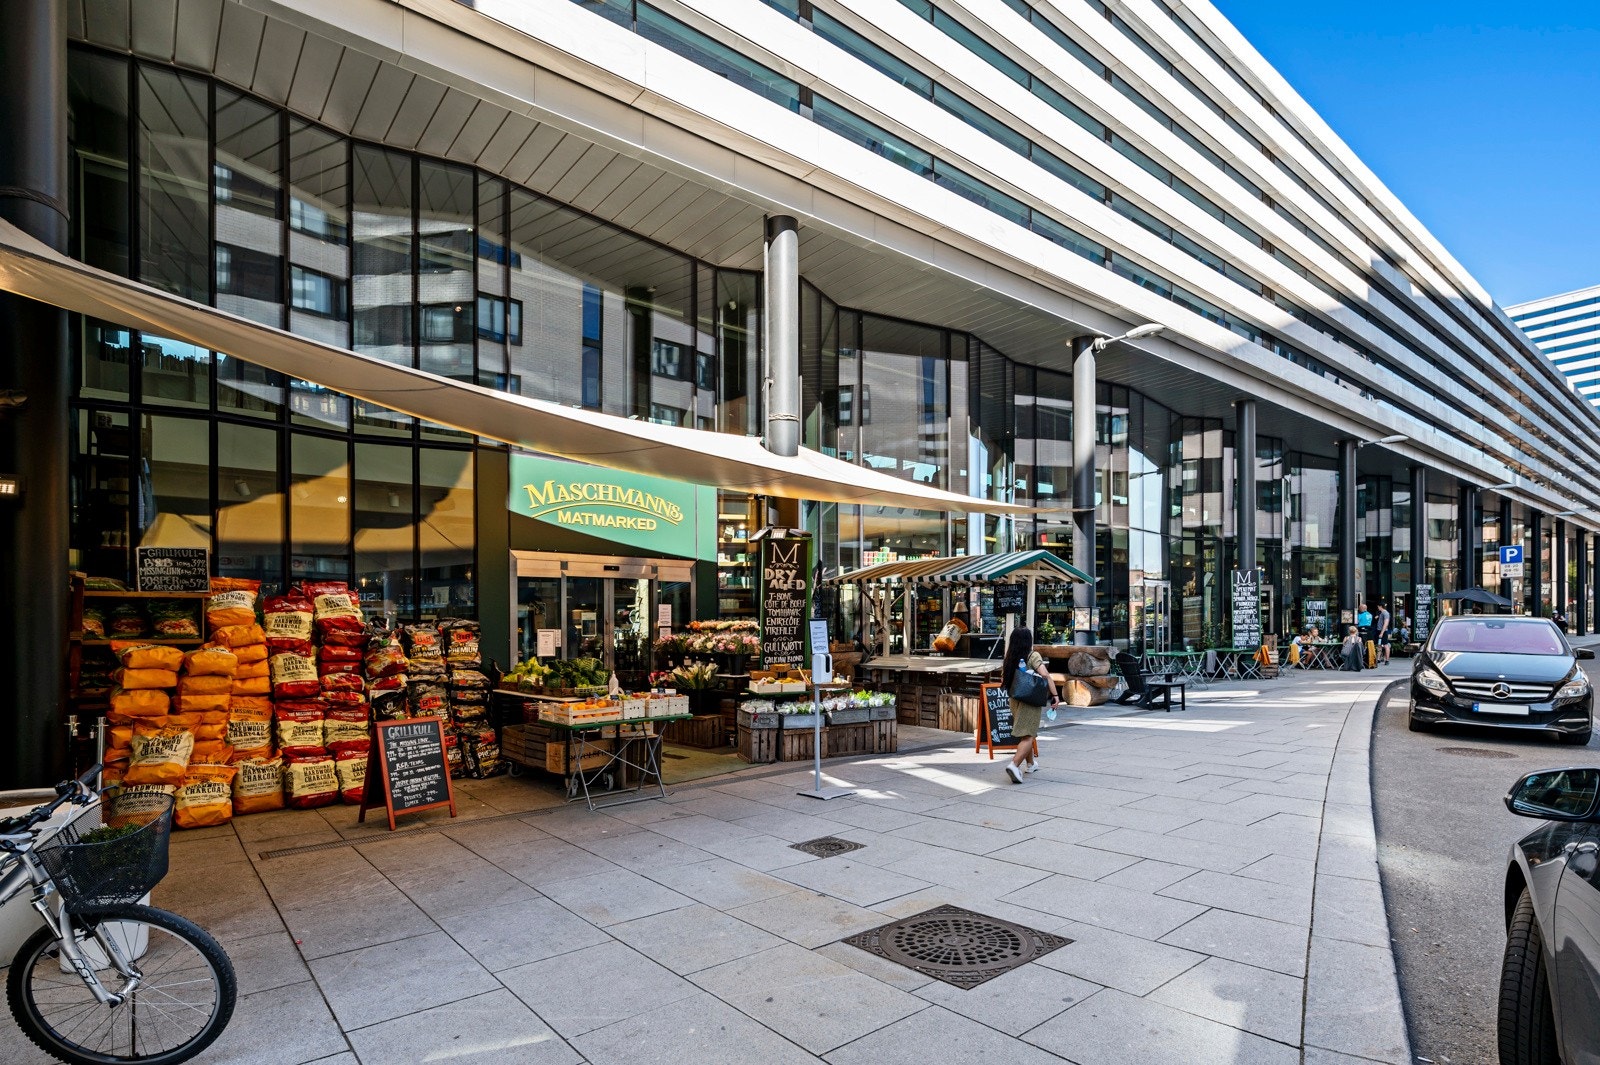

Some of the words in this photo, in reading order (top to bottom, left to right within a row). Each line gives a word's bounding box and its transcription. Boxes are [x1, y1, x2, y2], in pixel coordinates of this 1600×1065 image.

[523, 480, 684, 522] MASCHMANNS
[558, 510, 657, 531] MATMARKED
[147, 549, 198, 557] GRILLKULL
[771, 542, 801, 564] M
[1506, 548, 1518, 562] P
[764, 568, 797, 581] DRY
[1236, 570, 1252, 584] M
[769, 579, 806, 590] AGED
[767, 608, 801, 617] TOMAHAWK
[764, 641, 804, 653] GULLKJØTT
[388, 725, 431, 739] GRILLKULL
[242, 772, 279, 782] CHARCOAL
[304, 773, 333, 782] CHARCOAL
[185, 787, 225, 795] CHARCOAL
[70, 959, 97, 985] RST
